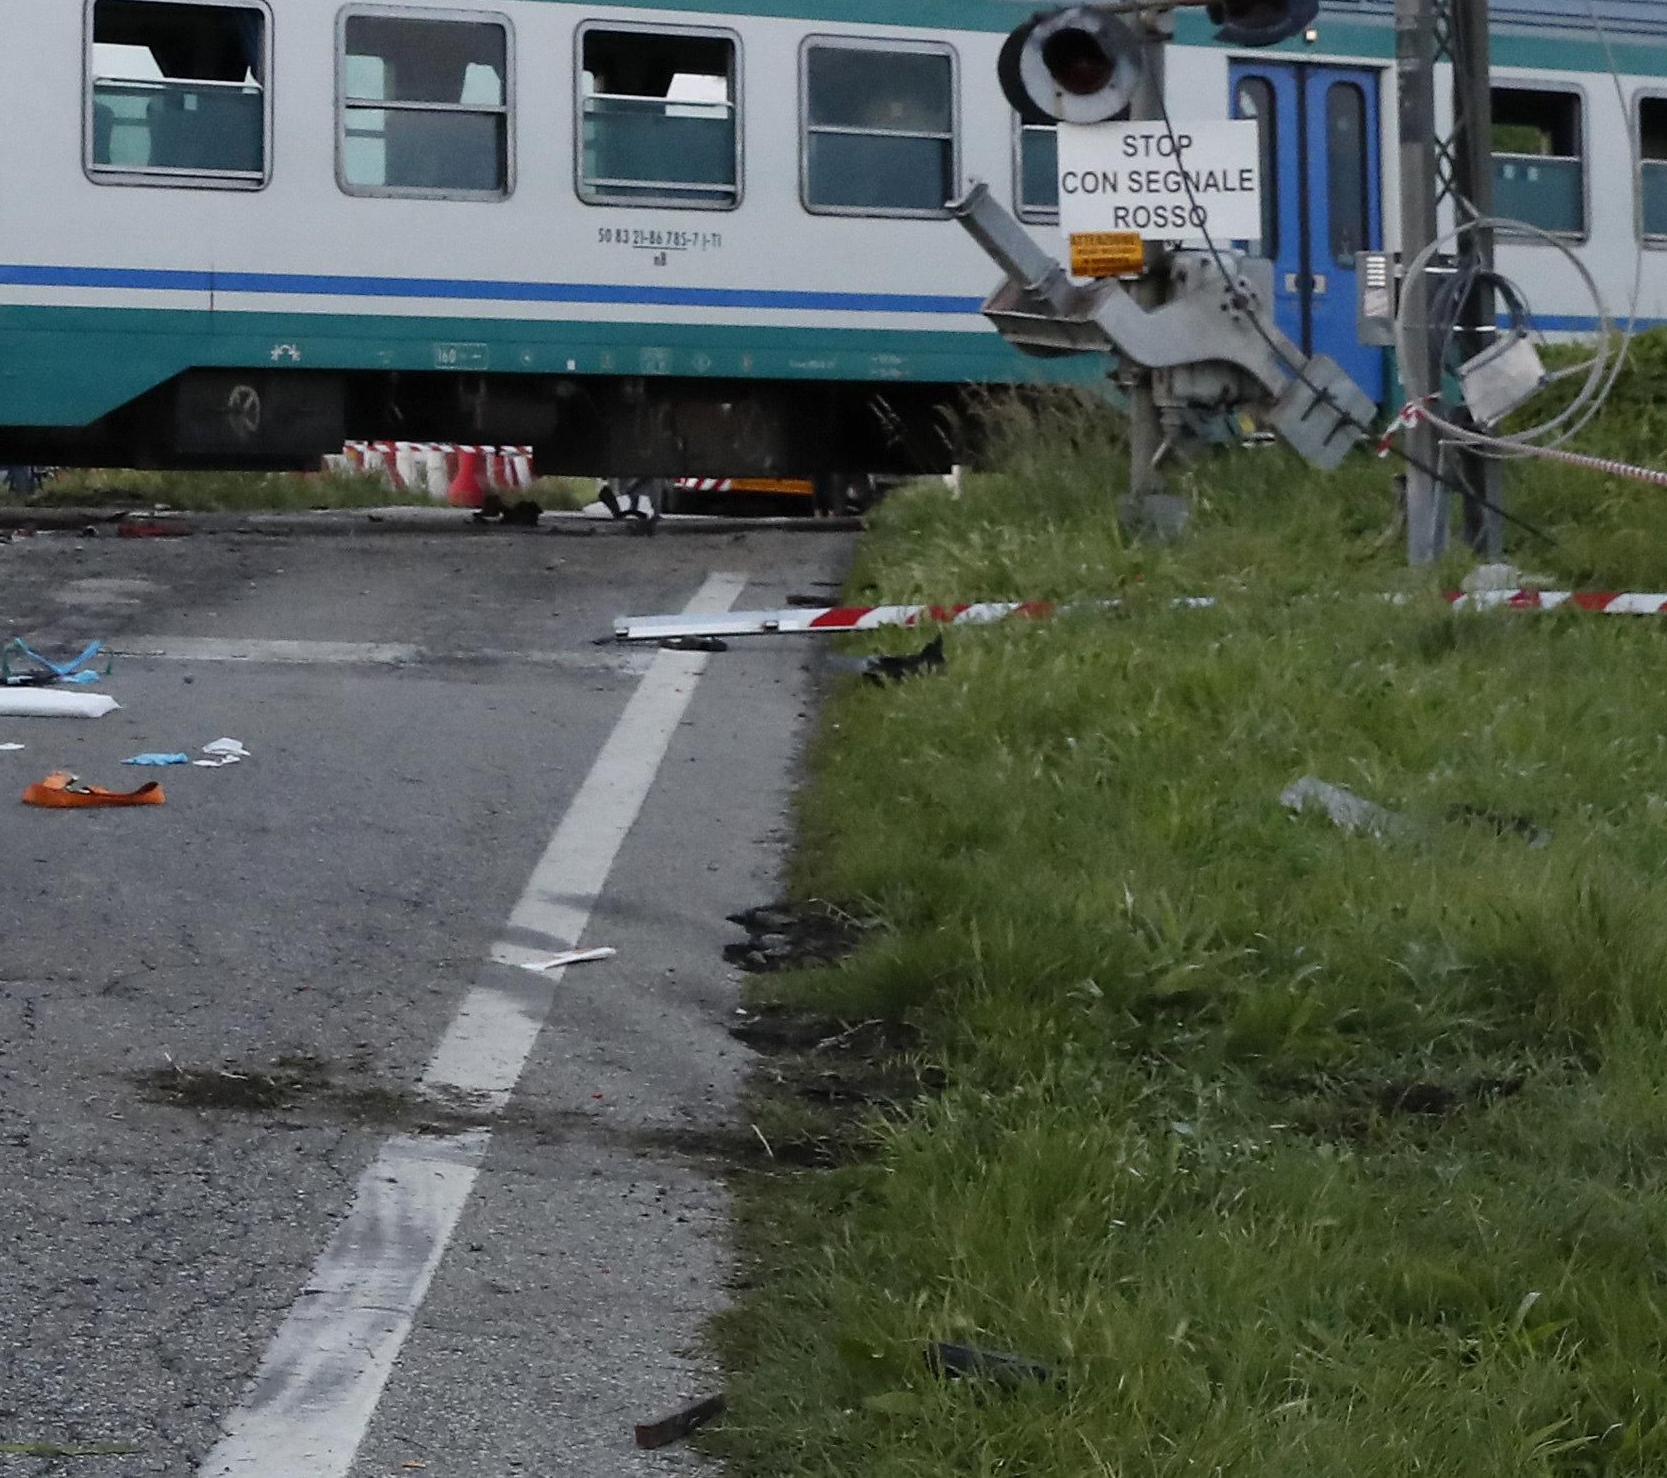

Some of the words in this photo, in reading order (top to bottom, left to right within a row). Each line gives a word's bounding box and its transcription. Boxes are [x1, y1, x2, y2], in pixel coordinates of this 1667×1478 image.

[1122, 134, 1193, 158] STOP
[1062, 171, 1118, 194] CON
[1127, 168, 1255, 194] SEGNALE
[1113, 204, 1208, 229] ROSSO
